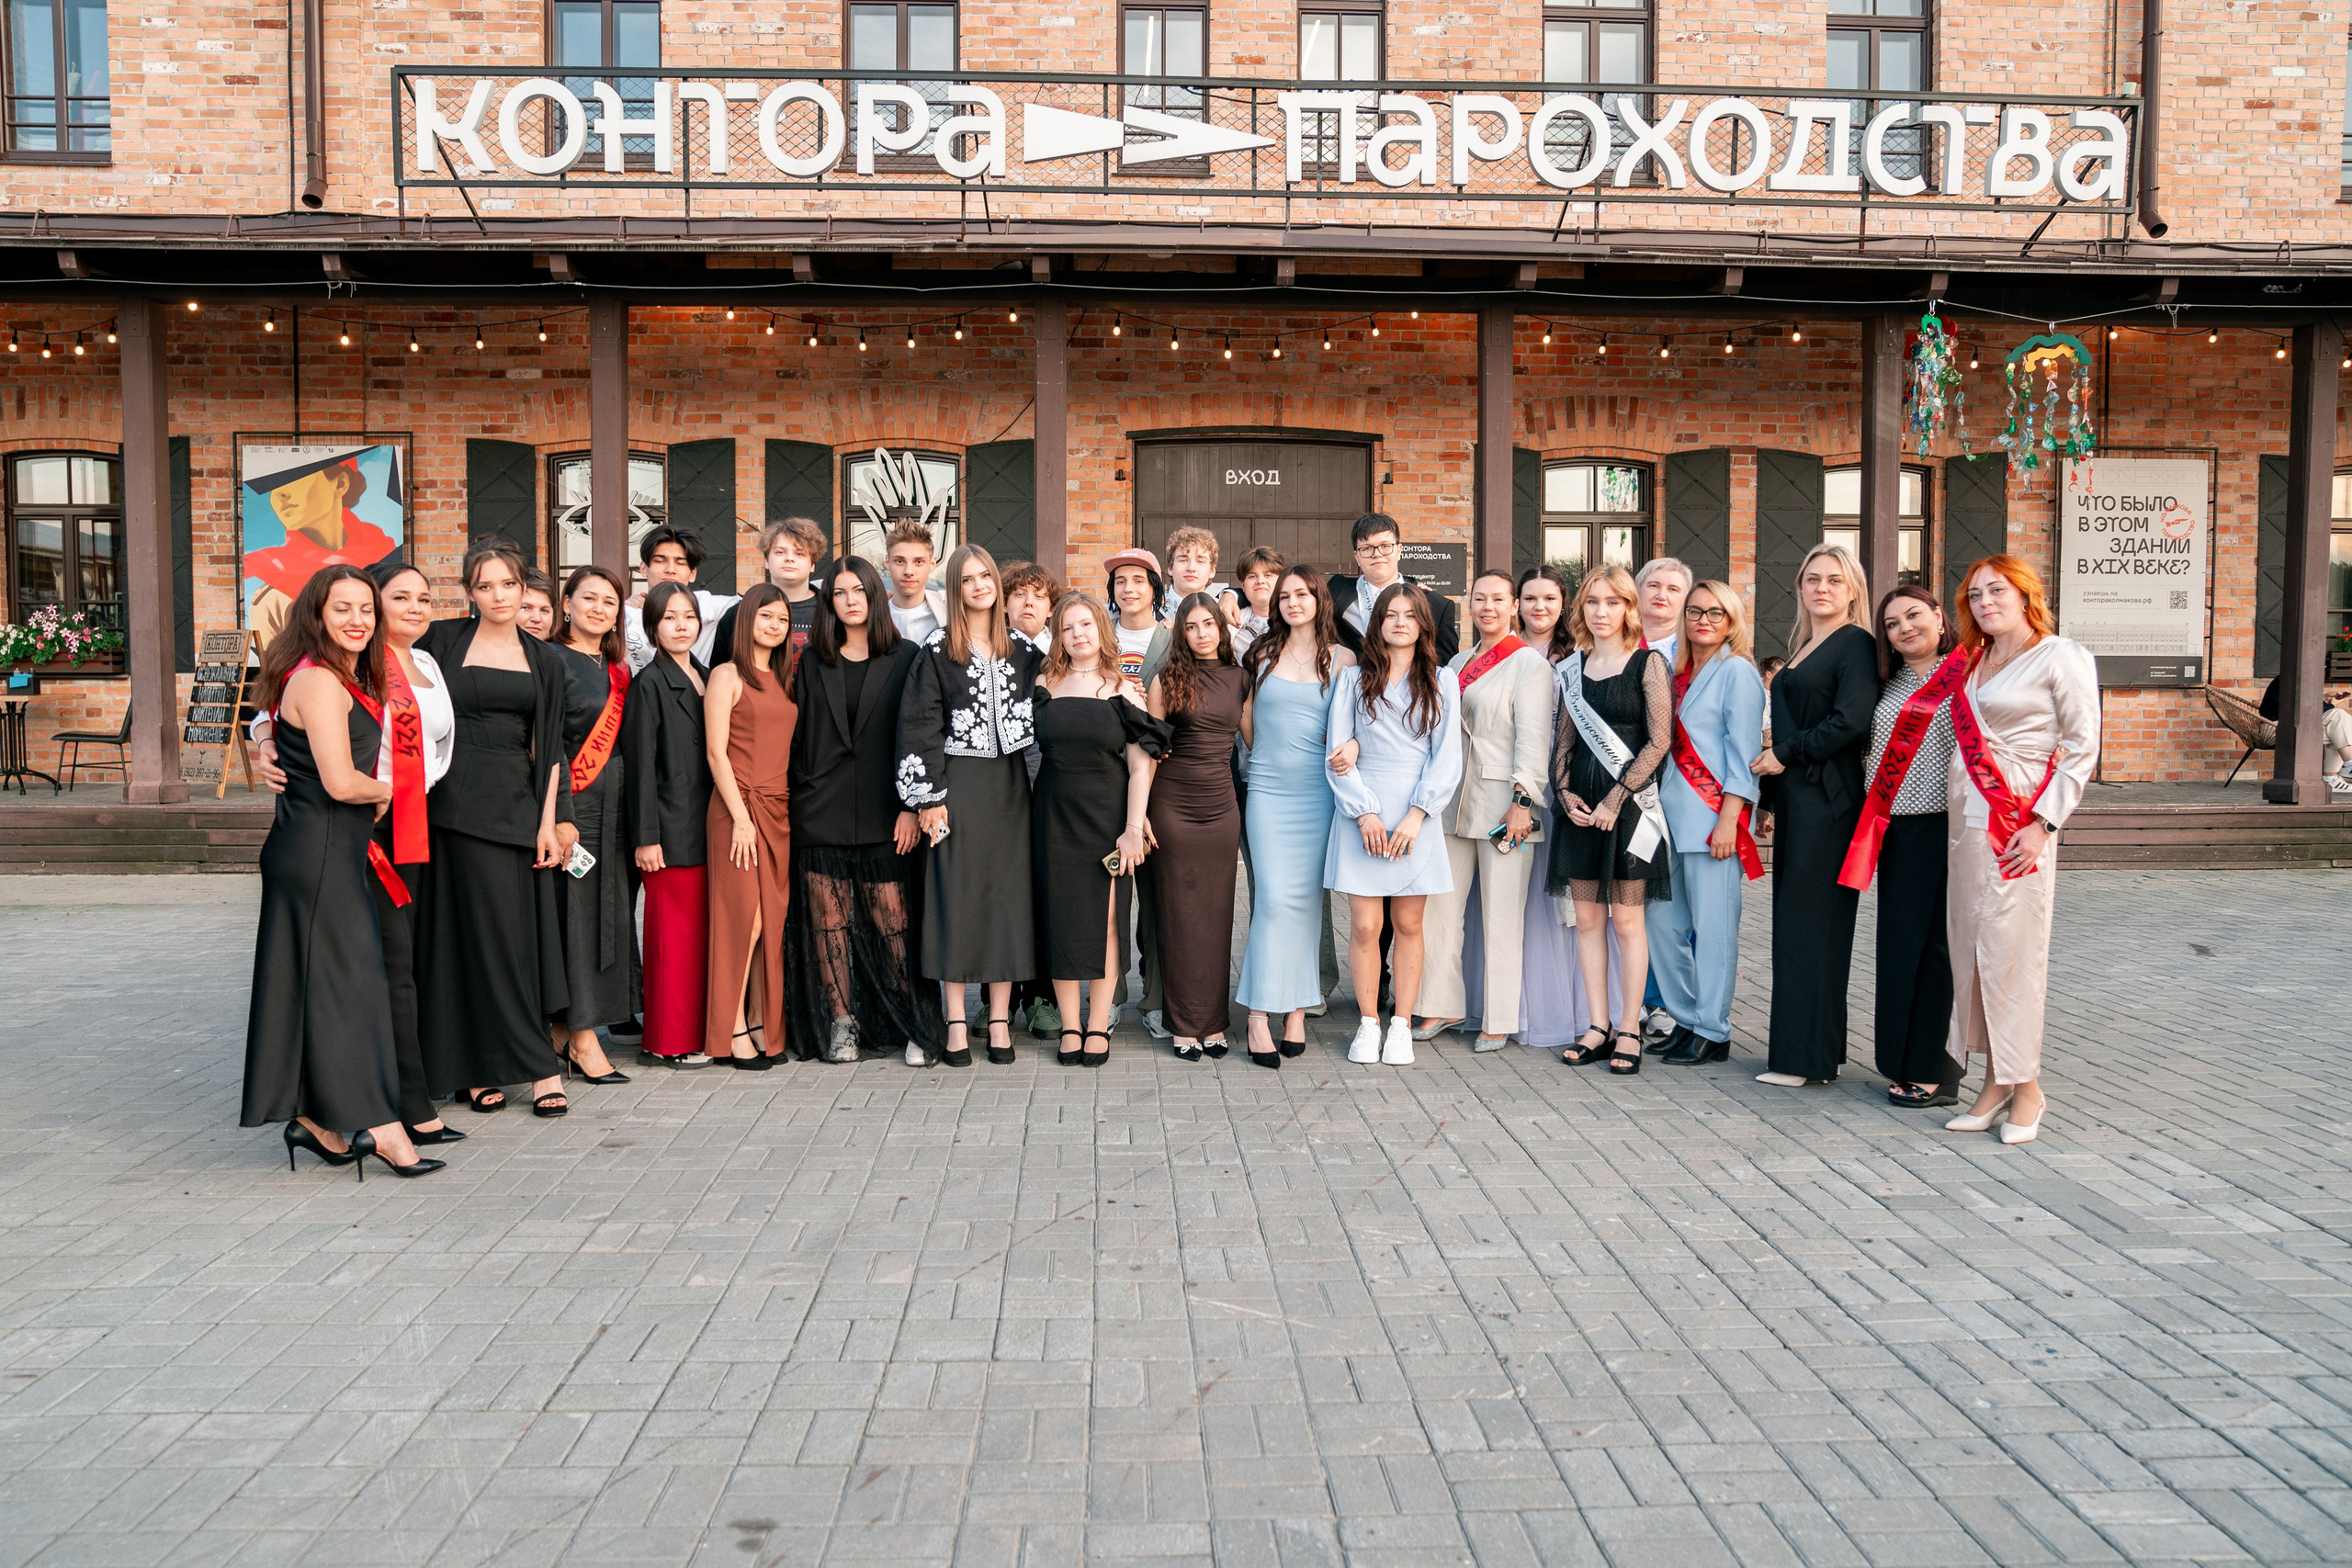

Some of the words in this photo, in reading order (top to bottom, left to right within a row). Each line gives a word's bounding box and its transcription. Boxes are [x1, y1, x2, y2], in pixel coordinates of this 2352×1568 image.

[1226, 469, 1281, 485] ВХОД
[2077, 495, 2116, 511] ЧТО
[2120, 496, 2177, 512] БЫЛО
[2078, 516, 2090, 532] В
[2094, 516, 2149, 533] ЭТОМ
[2109, 537, 2190, 557] ЗДАНИИ
[2077, 558, 2089, 574] В
[2091, 558, 2130, 575] XIX
[2133, 558, 2190, 575] ВЕКЕ?
[391, 697, 421, 758] 2025
[1874, 748, 1907, 806] 2025
